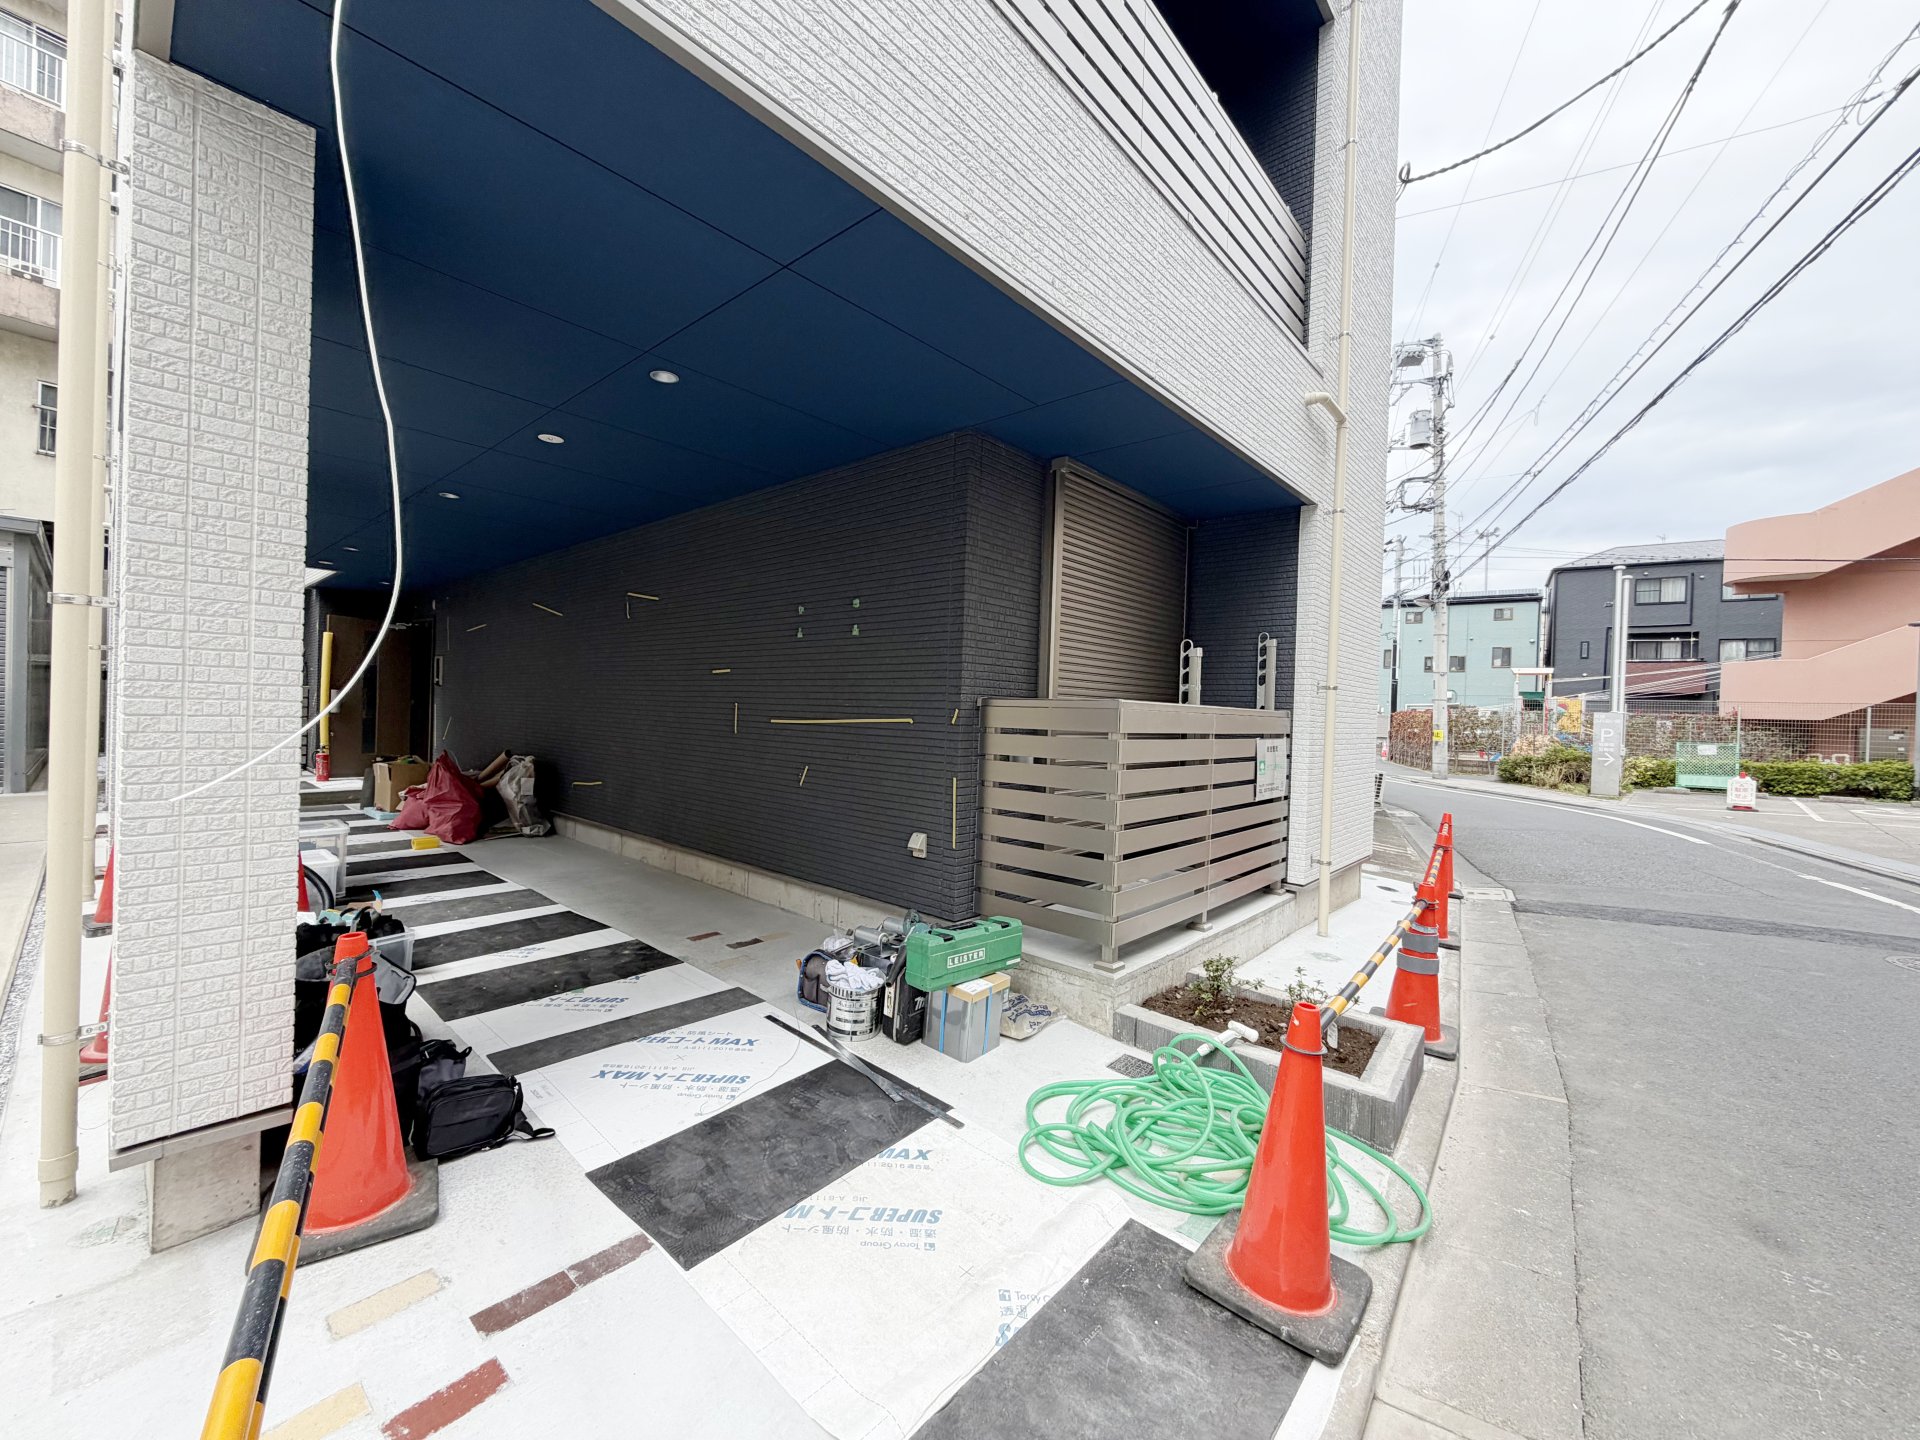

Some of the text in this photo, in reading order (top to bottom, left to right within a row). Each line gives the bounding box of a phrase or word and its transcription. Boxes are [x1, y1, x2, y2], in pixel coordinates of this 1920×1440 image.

[1601, 728, 1614, 742] P
[949, 950, 984, 966] LEISTER
[636, 1036, 760, 1047] PERコート MAX
[590, 1070, 751, 1085] SUPERコート MAX
[819, 1206, 943, 1224] SUPERコート
[860, 1240, 921, 1251] Toray Group
